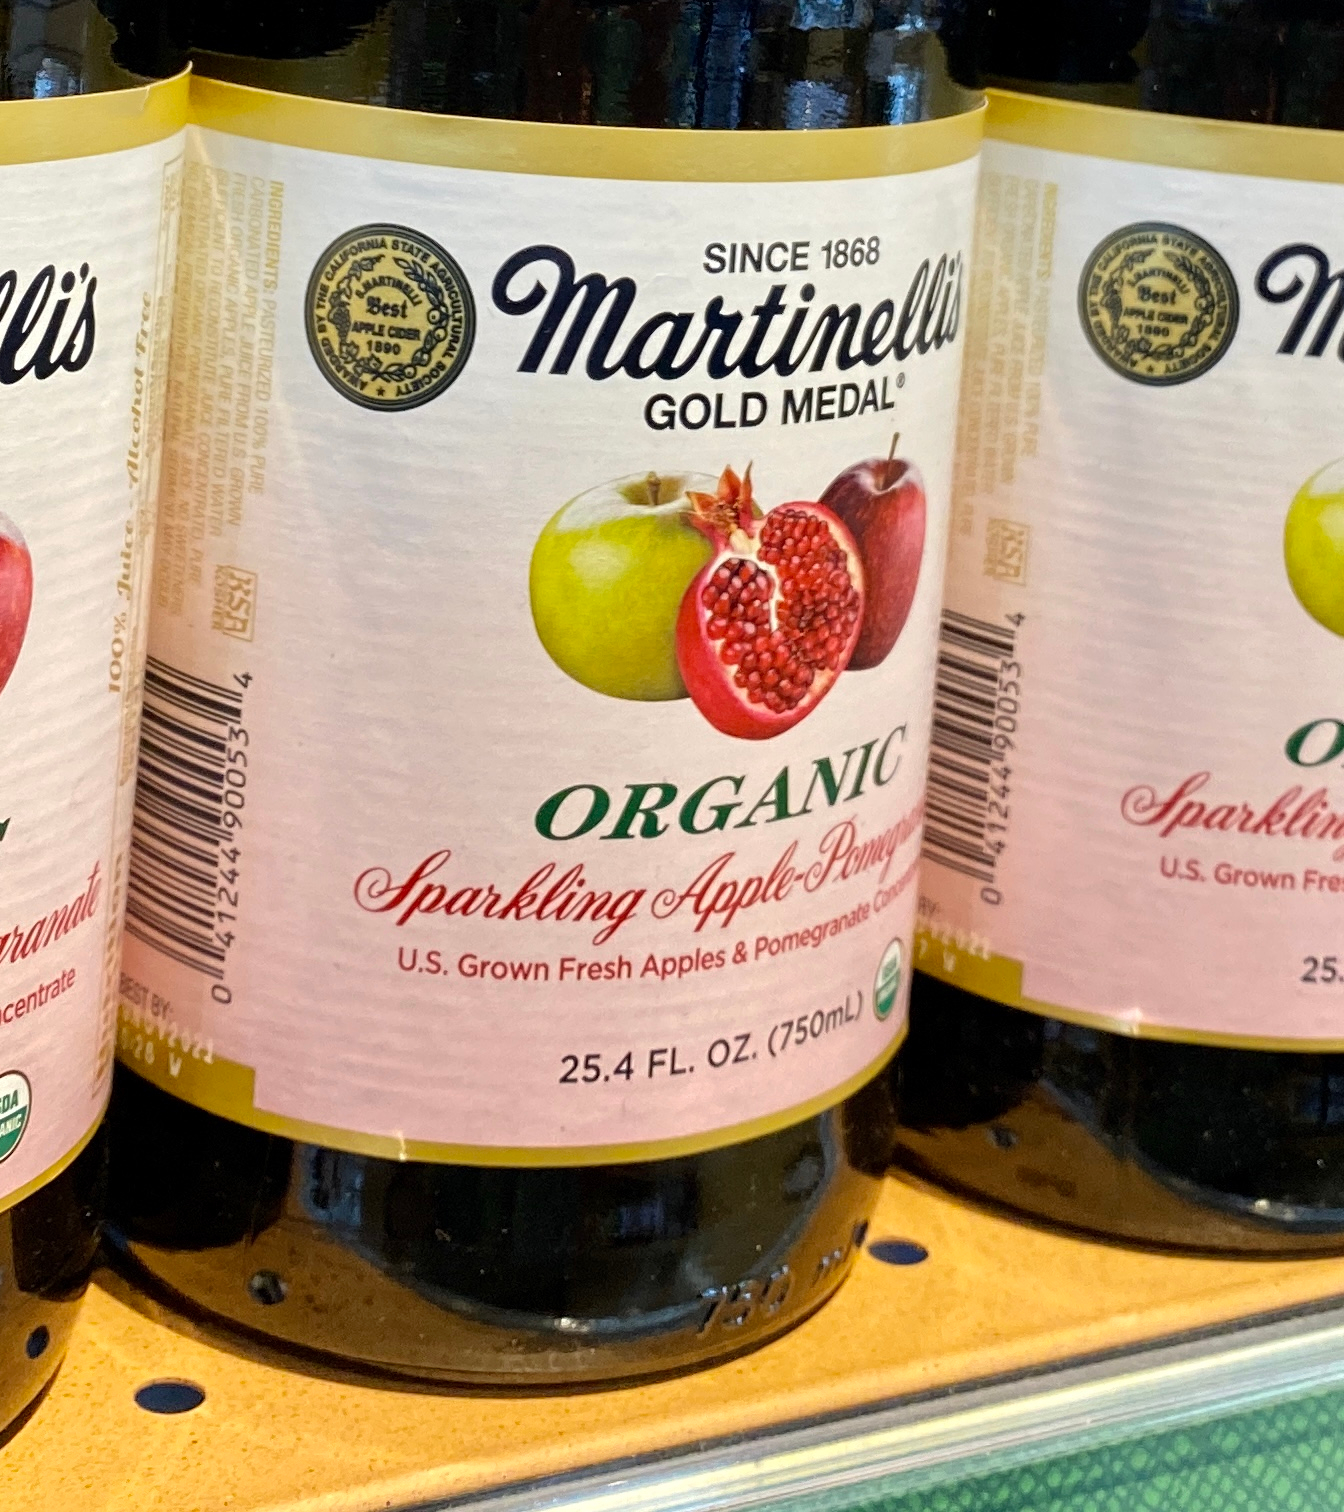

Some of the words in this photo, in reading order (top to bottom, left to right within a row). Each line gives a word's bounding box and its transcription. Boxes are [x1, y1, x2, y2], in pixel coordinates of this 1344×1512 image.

[263, 179, 286, 295] INGREDIENTS:
[325, 237, 388, 281] CALIFORNIA
[391, 239, 431, 263] STATE
[703, 240, 809, 275] SINCE
[821, 235, 881, 269] 1868
[315, 283, 329, 310] THE
[366, 295, 409, 319] Best
[429, 261, 463, 358] AGRICULTURAL
[135, 291, 152, 357] Free
[352, 321, 386, 337] APPLE
[388, 326, 421, 341] CIDER
[255, 298, 277, 402] PASTEURIZED
[366, 339, 402, 356] 1890
[395, 361, 446, 397] SOCIETY
[124, 365, 144, 486] Alcohol
[251, 407, 269, 449] 100%
[643, 392, 768, 433] GOLD
[248, 454, 267, 495] PURE
[115, 519, 135, 600] Juice
[107, 611, 128, 694] 100%
[234, 671, 253, 690] 4
[222, 727, 251, 830] 90053
[533, 724, 909, 843] ORGANIC
[1159, 857, 1207, 883] U.S.
[1213, 862, 1295, 889] Grown
[214, 840, 243, 958] 41244
[354, 849, 644, 946] Sparkling
[397, 947, 449, 977] U.S.
[458, 953, 550, 982] Grown
[559, 955, 633, 982] Fresh
[640, 947, 726, 982] Apples
[732, 941, 749, 964] &
[754, 900, 870, 963] Pomegranate
[211, 984, 232, 1004] 0
[559, 1053, 635, 1085] 25.4
[648, 1046, 695, 1080] FL.
[707, 1034, 757, 1070] OZ.
[767, 990, 865, 1060] (750mL)
